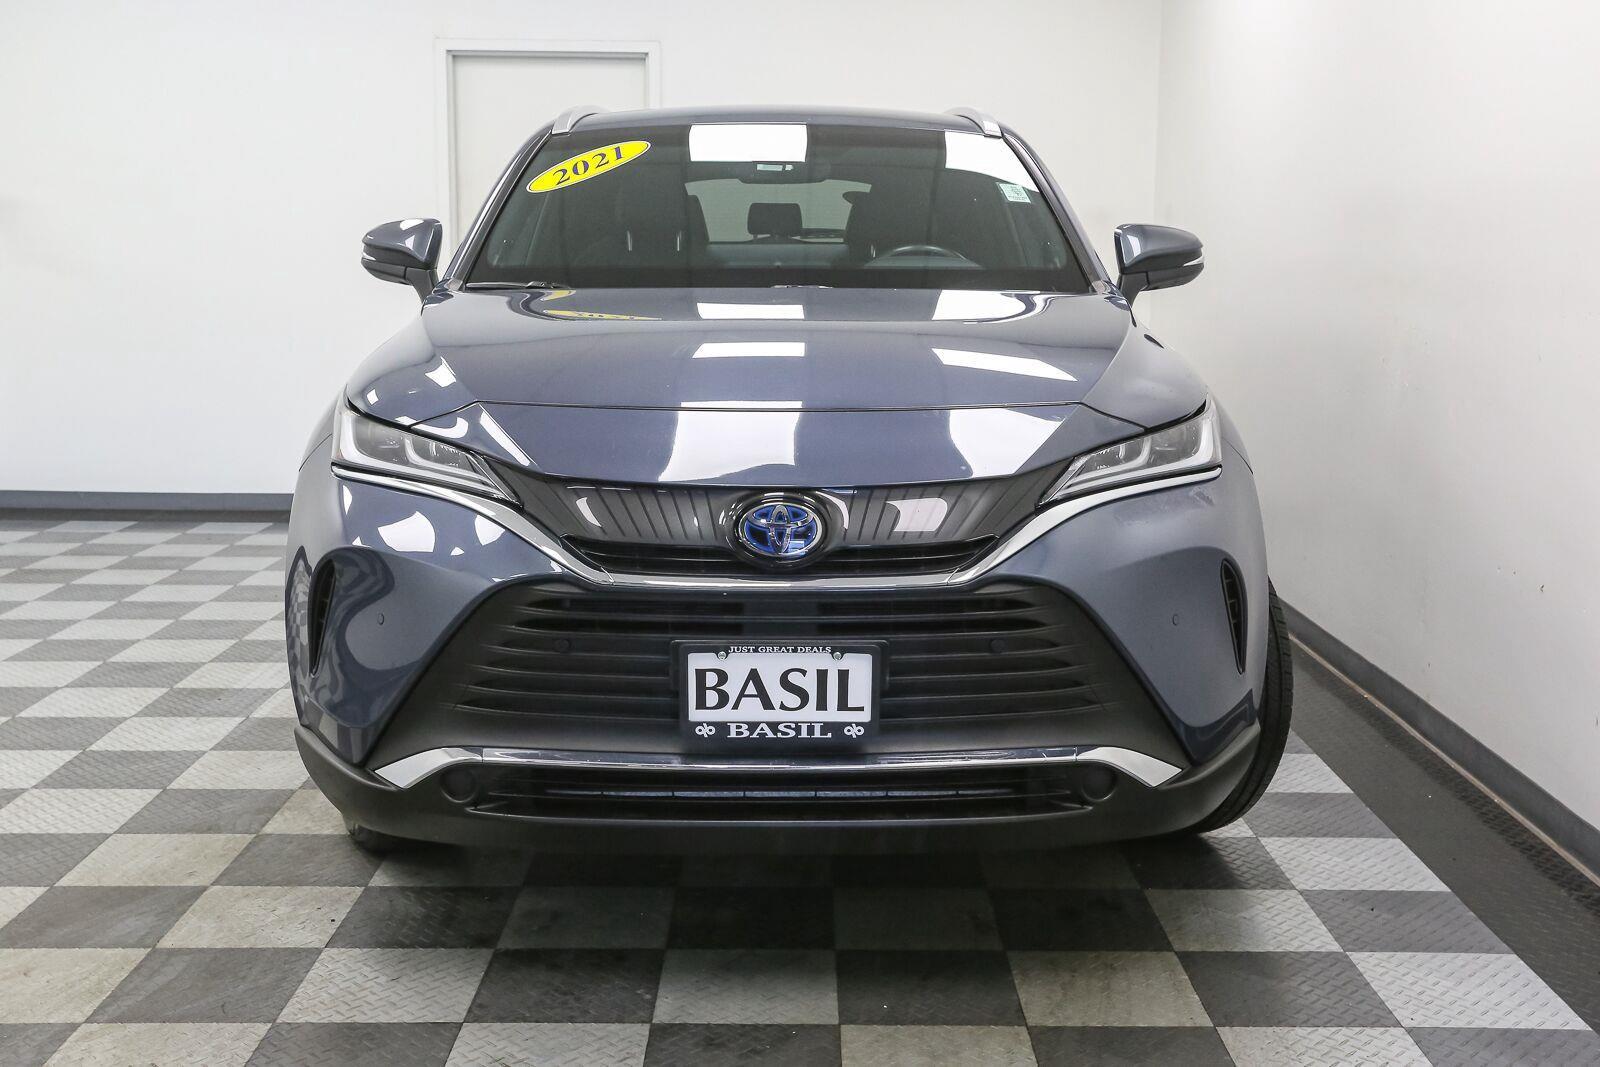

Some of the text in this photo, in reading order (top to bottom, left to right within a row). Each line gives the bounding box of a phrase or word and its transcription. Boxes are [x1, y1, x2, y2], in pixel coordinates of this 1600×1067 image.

[553, 146, 623, 185] 2021
[694, 667, 865, 712] BASIL
[726, 722, 832, 738] BASIL
